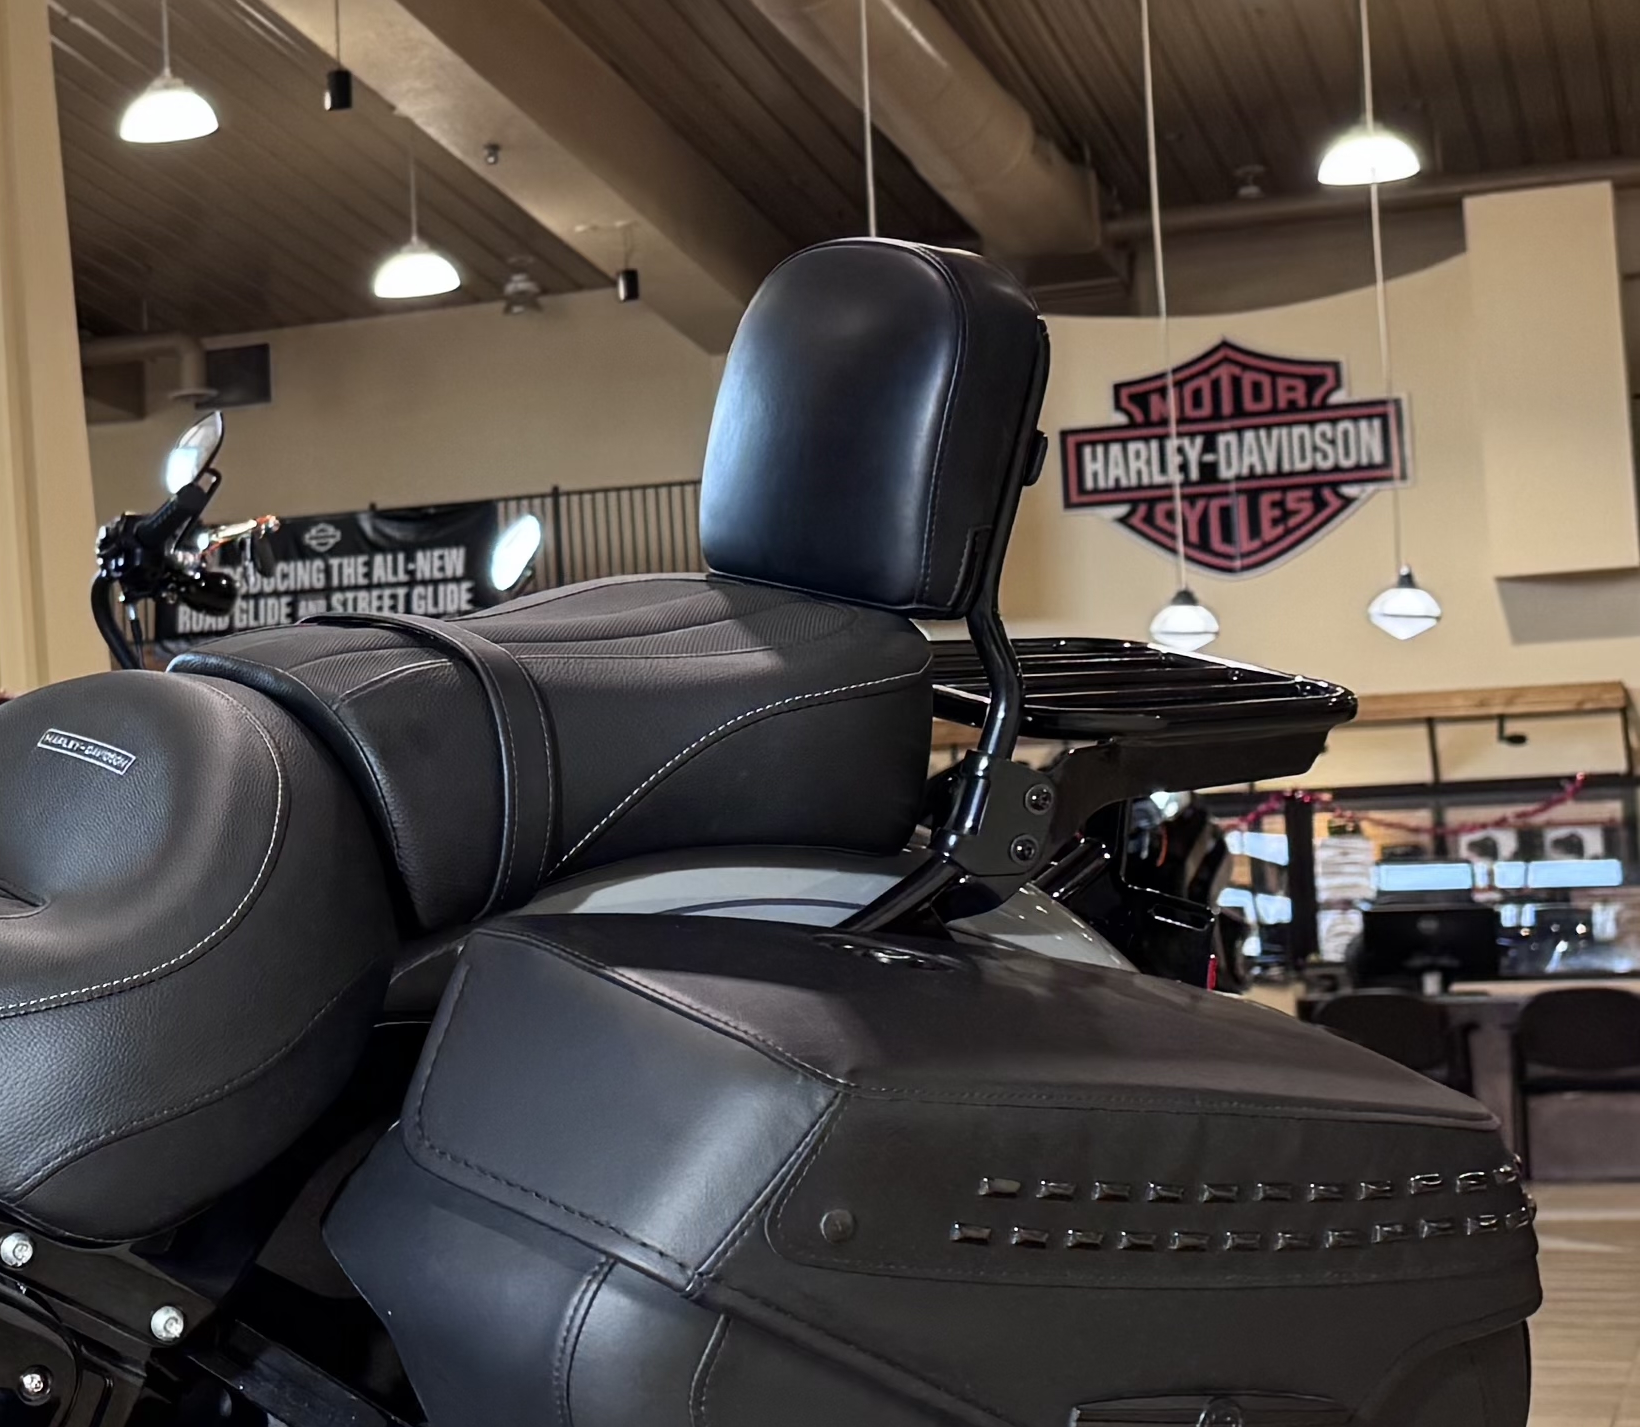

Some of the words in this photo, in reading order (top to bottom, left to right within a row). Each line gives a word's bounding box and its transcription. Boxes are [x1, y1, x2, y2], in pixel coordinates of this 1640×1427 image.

[1149, 365, 1307, 421] MOTOR
[1082, 418, 1385, 491] HARLEY-DAVIDSON
[1153, 489, 1315, 555] CYCLES
[329, 556, 370, 587] THE
[373, 547, 466, 584] ALL-NEW
[234, 595, 292, 627] GLIDE
[331, 586, 408, 614] STREET
[411, 581, 475, 615] GLIDE
